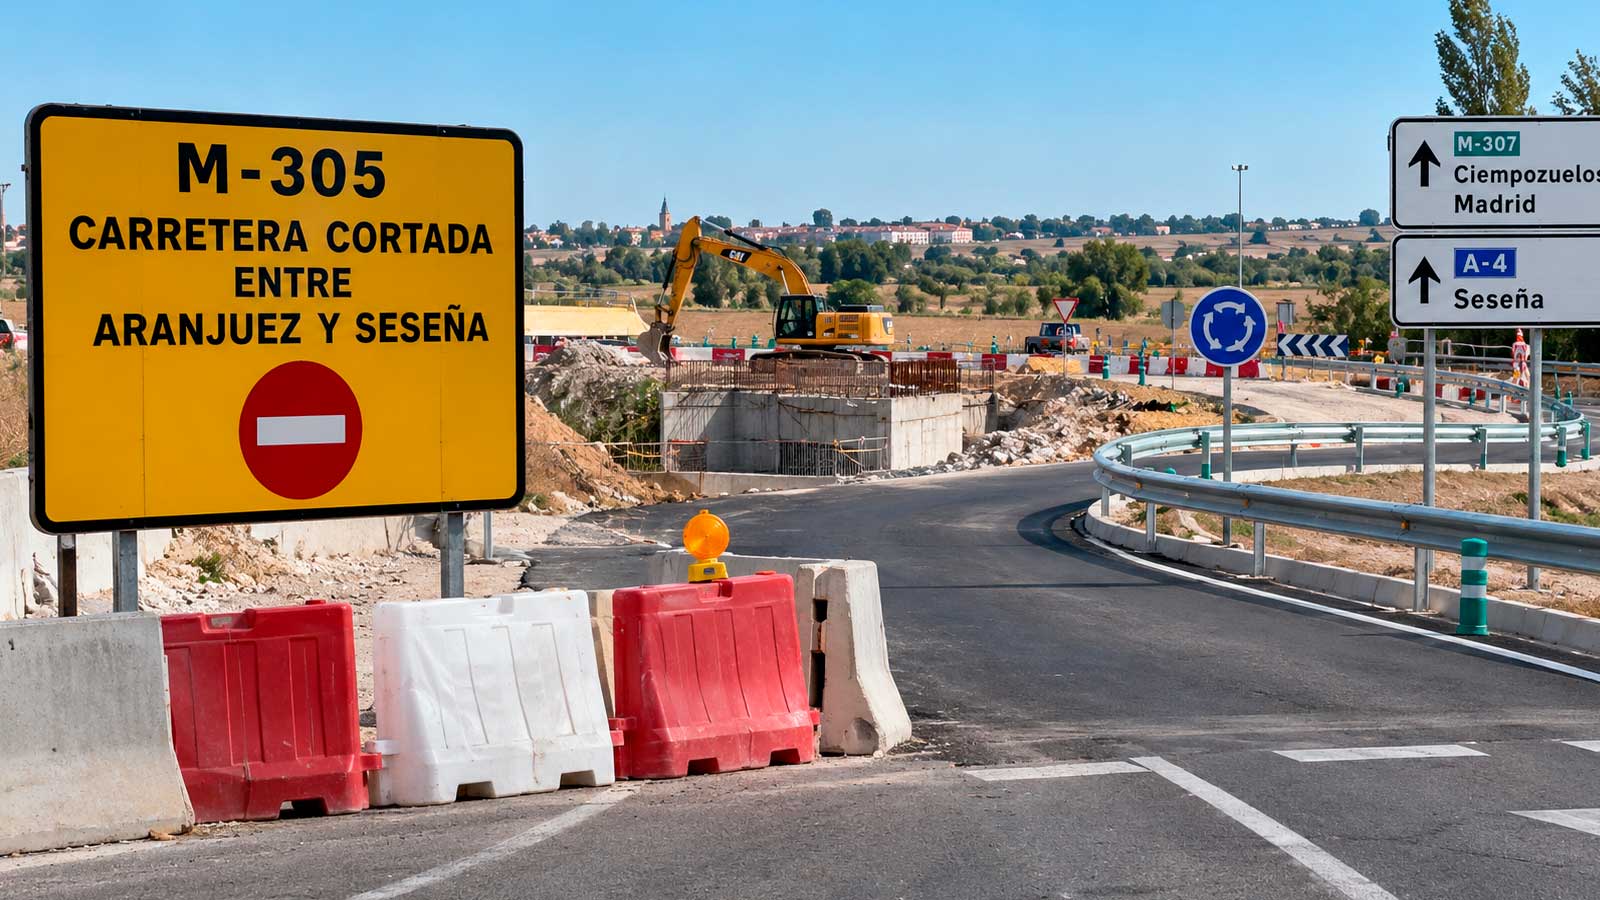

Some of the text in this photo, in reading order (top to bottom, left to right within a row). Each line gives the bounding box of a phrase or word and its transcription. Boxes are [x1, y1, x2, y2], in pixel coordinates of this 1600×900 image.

[1457, 135, 1518, 152] M-307
[177, 141, 386, 199] M-305
[1454, 193, 1536, 214] Madrid
[69, 214, 494, 255] CARRETERA CORTADA
[1463, 253, 1507, 273] A-4
[234, 266, 352, 298] ENTRE
[1454, 287, 1544, 310] Seseña
[93, 303, 490, 347] ARANJUEZ Y SESEÑA
